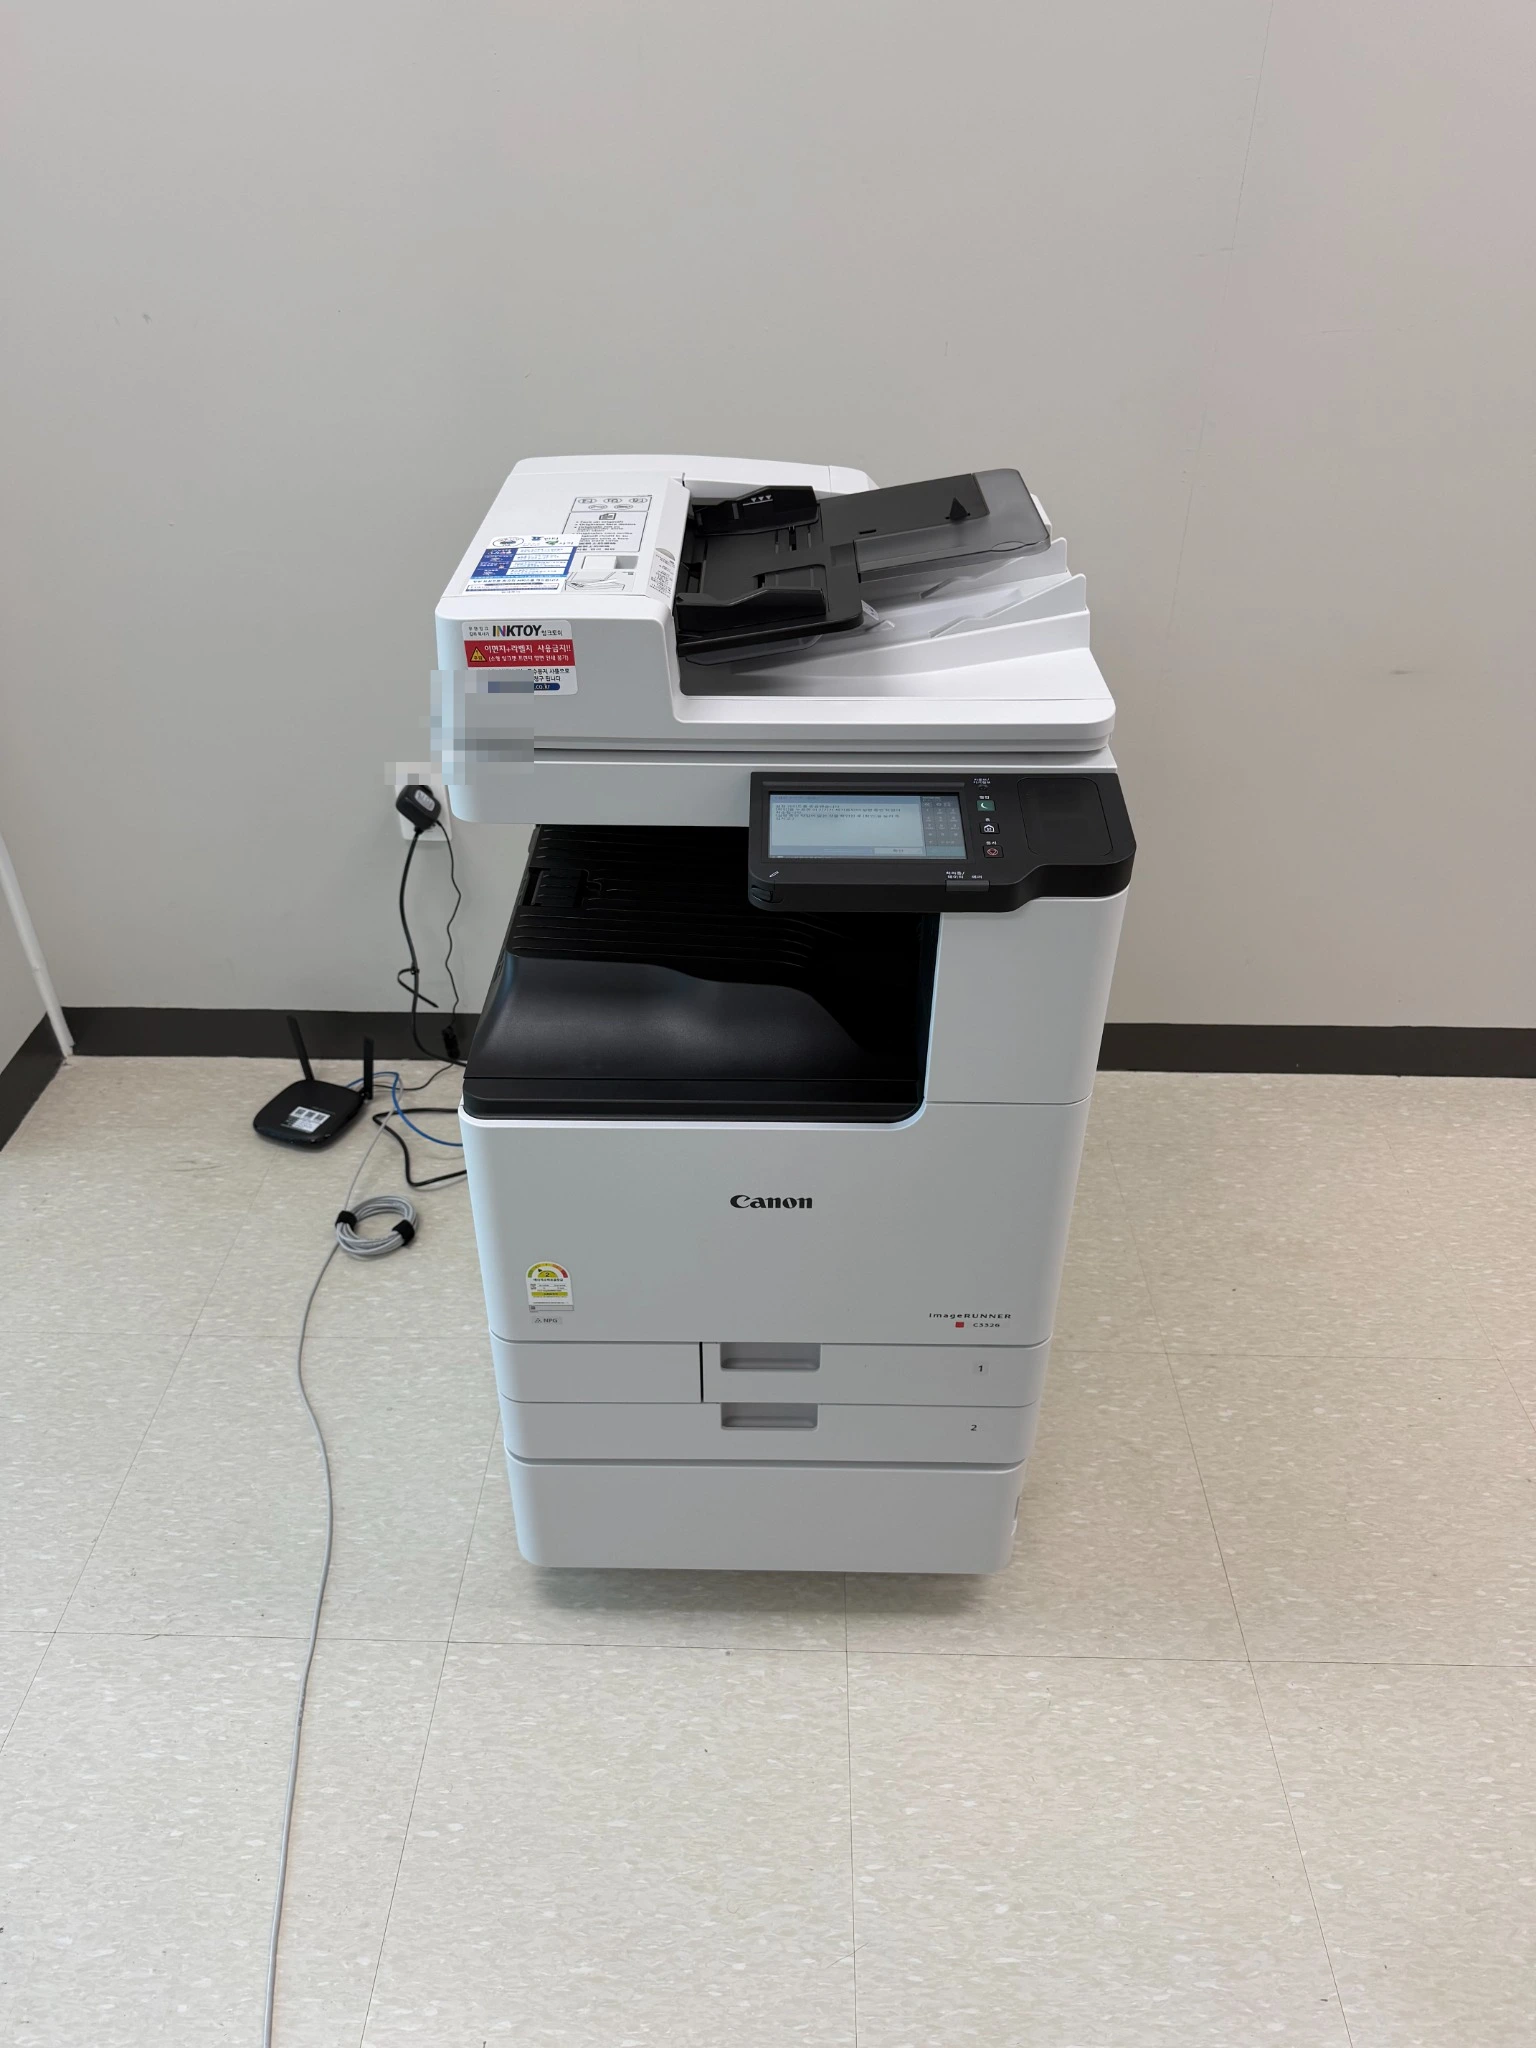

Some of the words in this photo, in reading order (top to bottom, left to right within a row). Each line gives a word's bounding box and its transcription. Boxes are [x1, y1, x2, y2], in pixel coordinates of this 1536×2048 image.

[493, 624, 542, 637] INKTOY
[484, 644, 533, 653] 이면지+라벨지
[537, 644, 572, 653] 사용금지!!
[729, 1194, 813, 1209] Canon
[928, 1312, 1012, 1320] imageRUNNER
[978, 1364, 983, 1372] 1
[970, 1424, 978, 1432] 2
